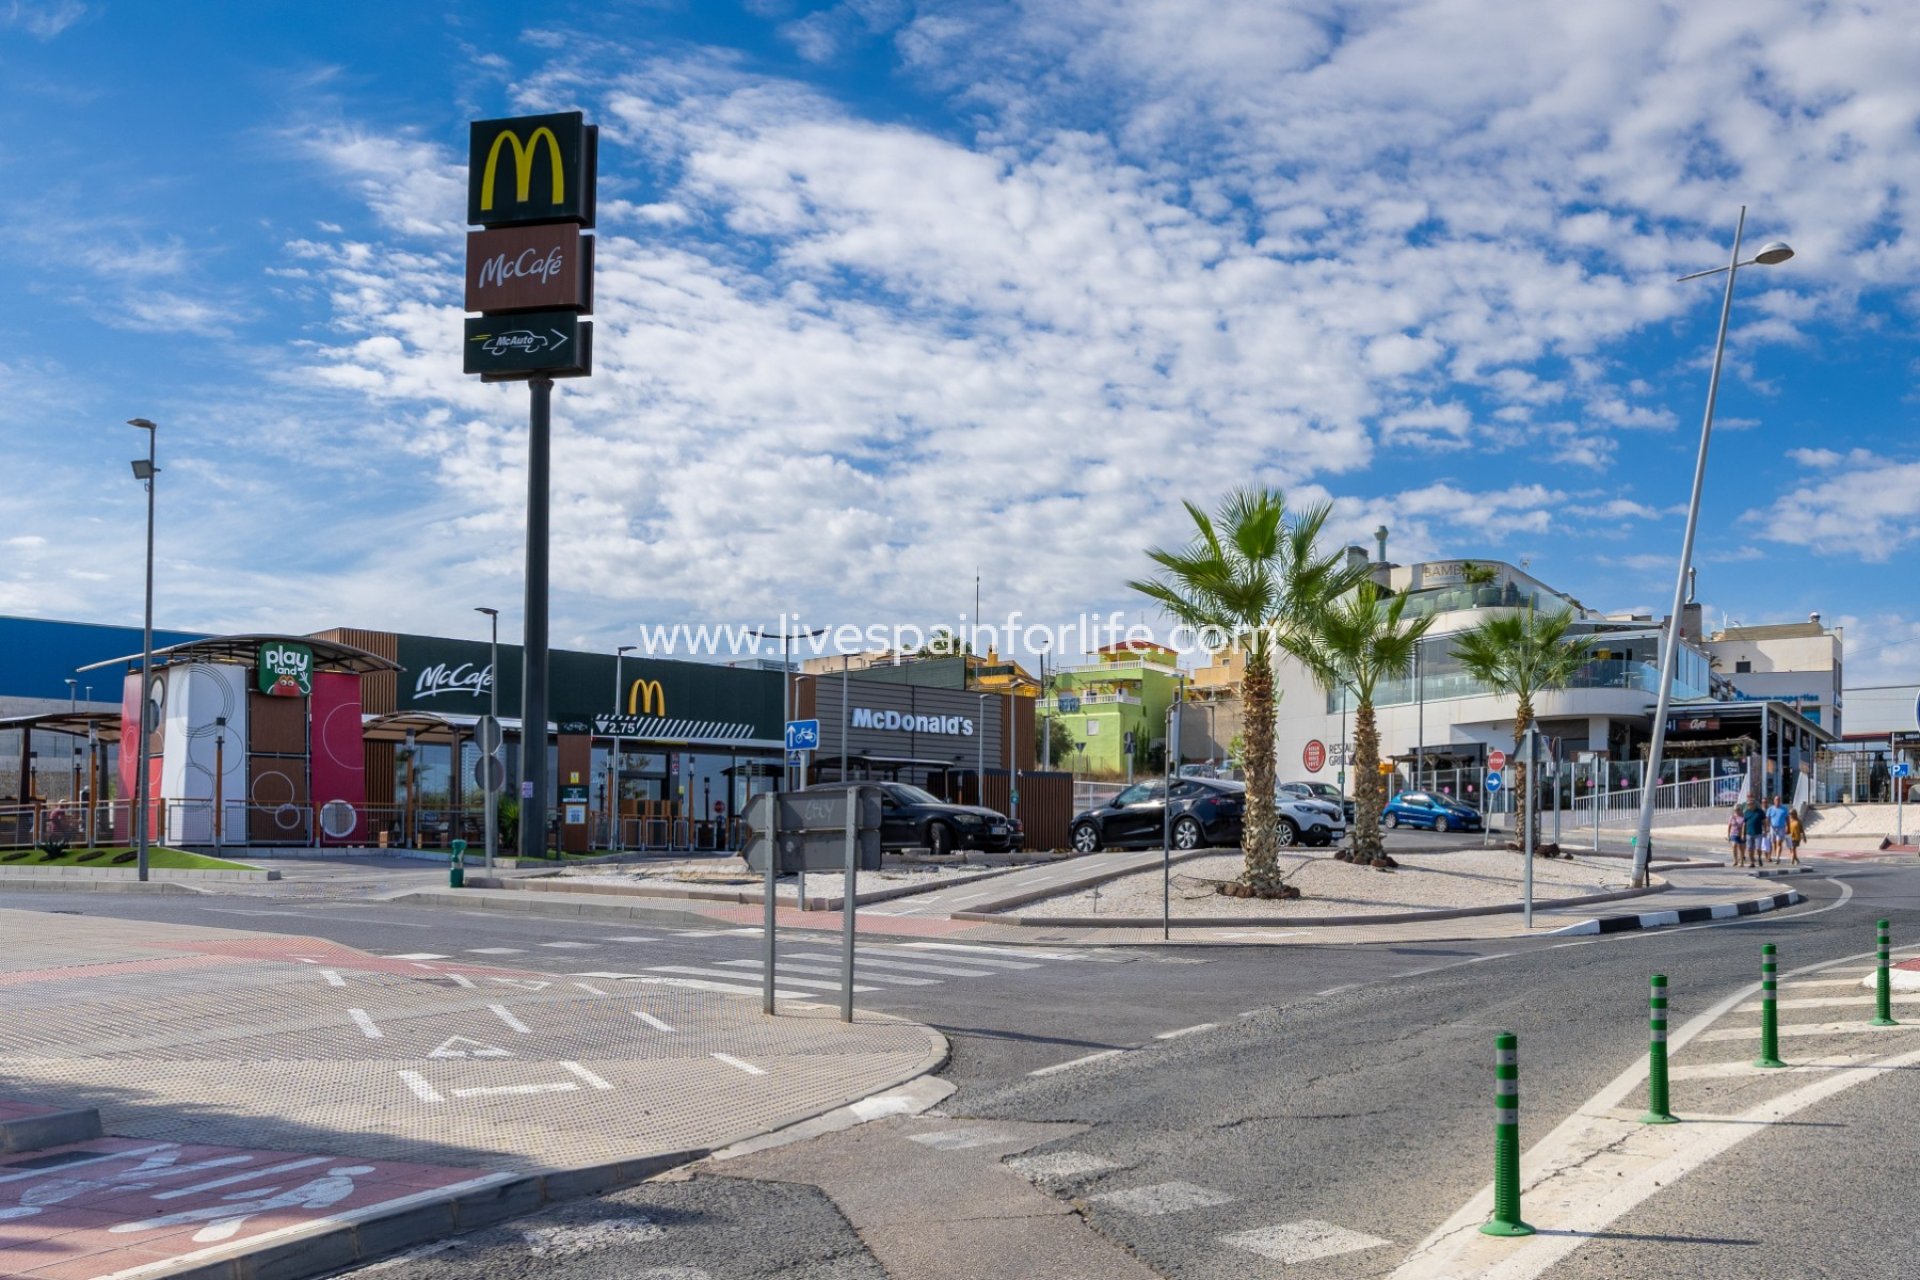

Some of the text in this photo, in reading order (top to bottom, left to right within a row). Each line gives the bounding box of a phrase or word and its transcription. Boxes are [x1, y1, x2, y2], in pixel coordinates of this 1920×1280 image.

[479, 246, 563, 288] McCafé
[496, 333, 535, 346] McAuto
[265, 644, 309, 672] play
[274, 663, 297, 676] land
[609, 722, 635, 734] 2.75
[851, 707, 974, 737] McDonald's
[1892, 765, 1901, 775] P
